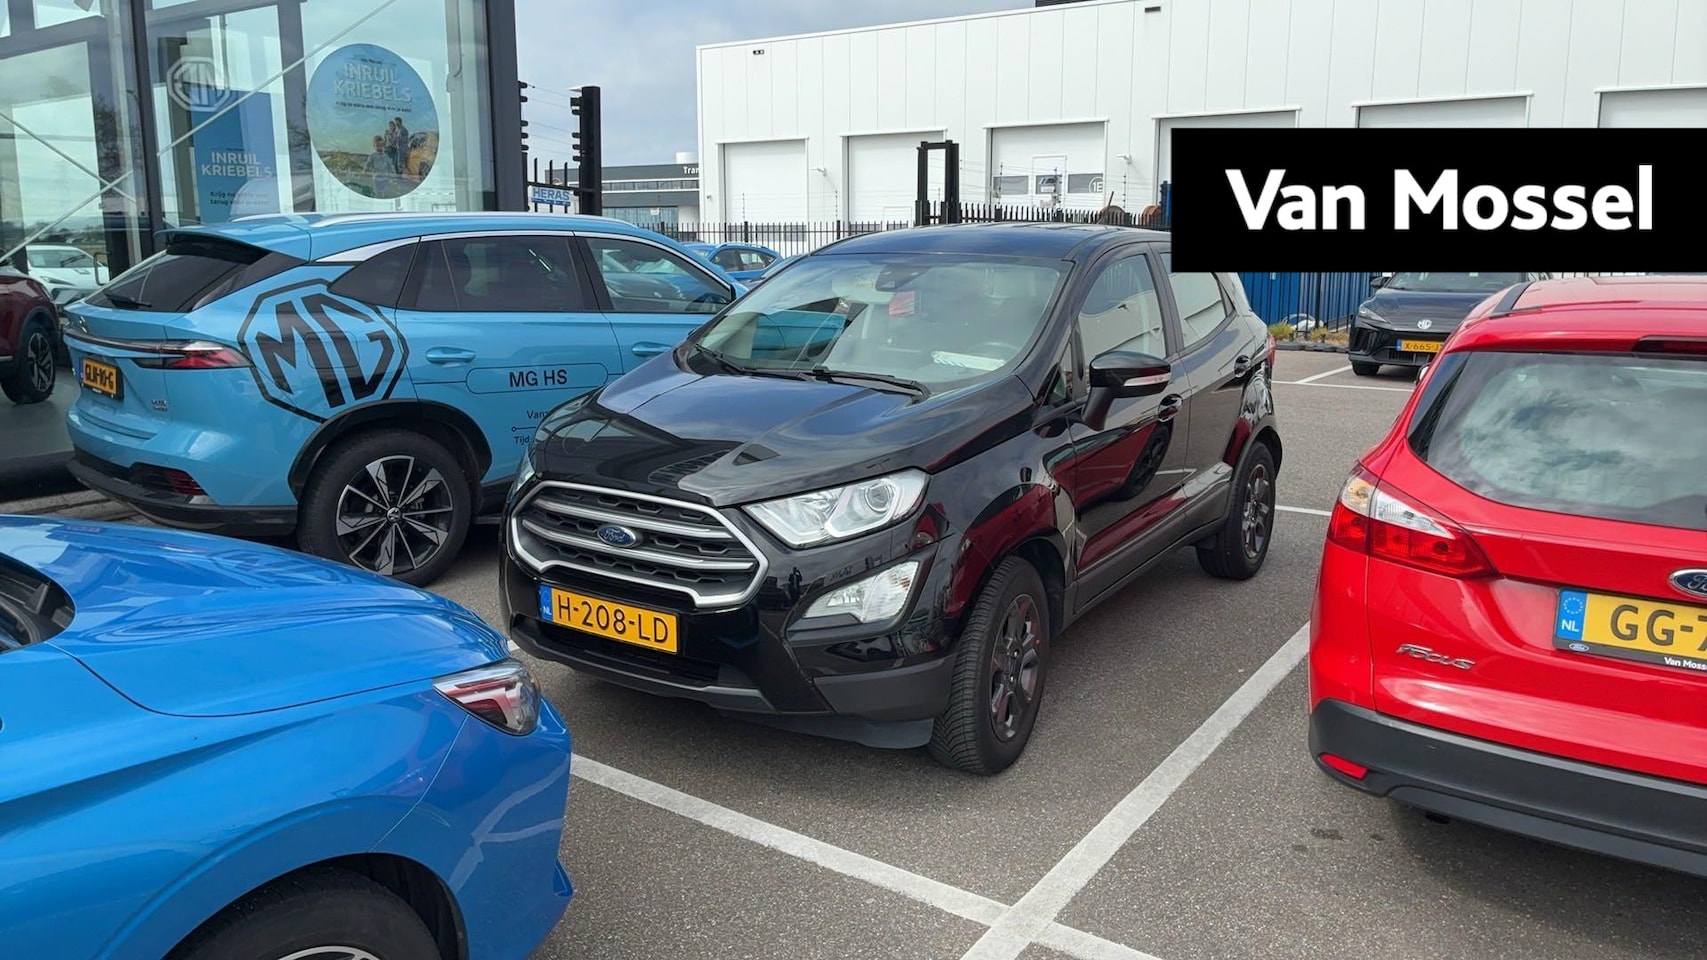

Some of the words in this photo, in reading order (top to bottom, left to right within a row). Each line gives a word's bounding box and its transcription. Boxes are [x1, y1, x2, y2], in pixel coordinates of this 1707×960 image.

[344, 63, 399, 84] INRUIL
[334, 79, 412, 103] KRIEBELS
[211, 152, 261, 166] INRUIL
[201, 164, 273, 178] KRIEBELS
[533, 187, 570, 201] HERAS
[255, 293, 395, 408] MG
[509, 371, 538, 388] MG
[544, 369, 568, 385] HS
[526, 410, 548, 419] Van
[603, 529, 626, 543] Ford
[543, 605, 552, 616] NL
[557, 594, 669, 643] H-208-LD
[1561, 619, 1579, 632] NL
[1664, 656, 1681, 667] Van
[1683, 659, 1707, 670] Moss
